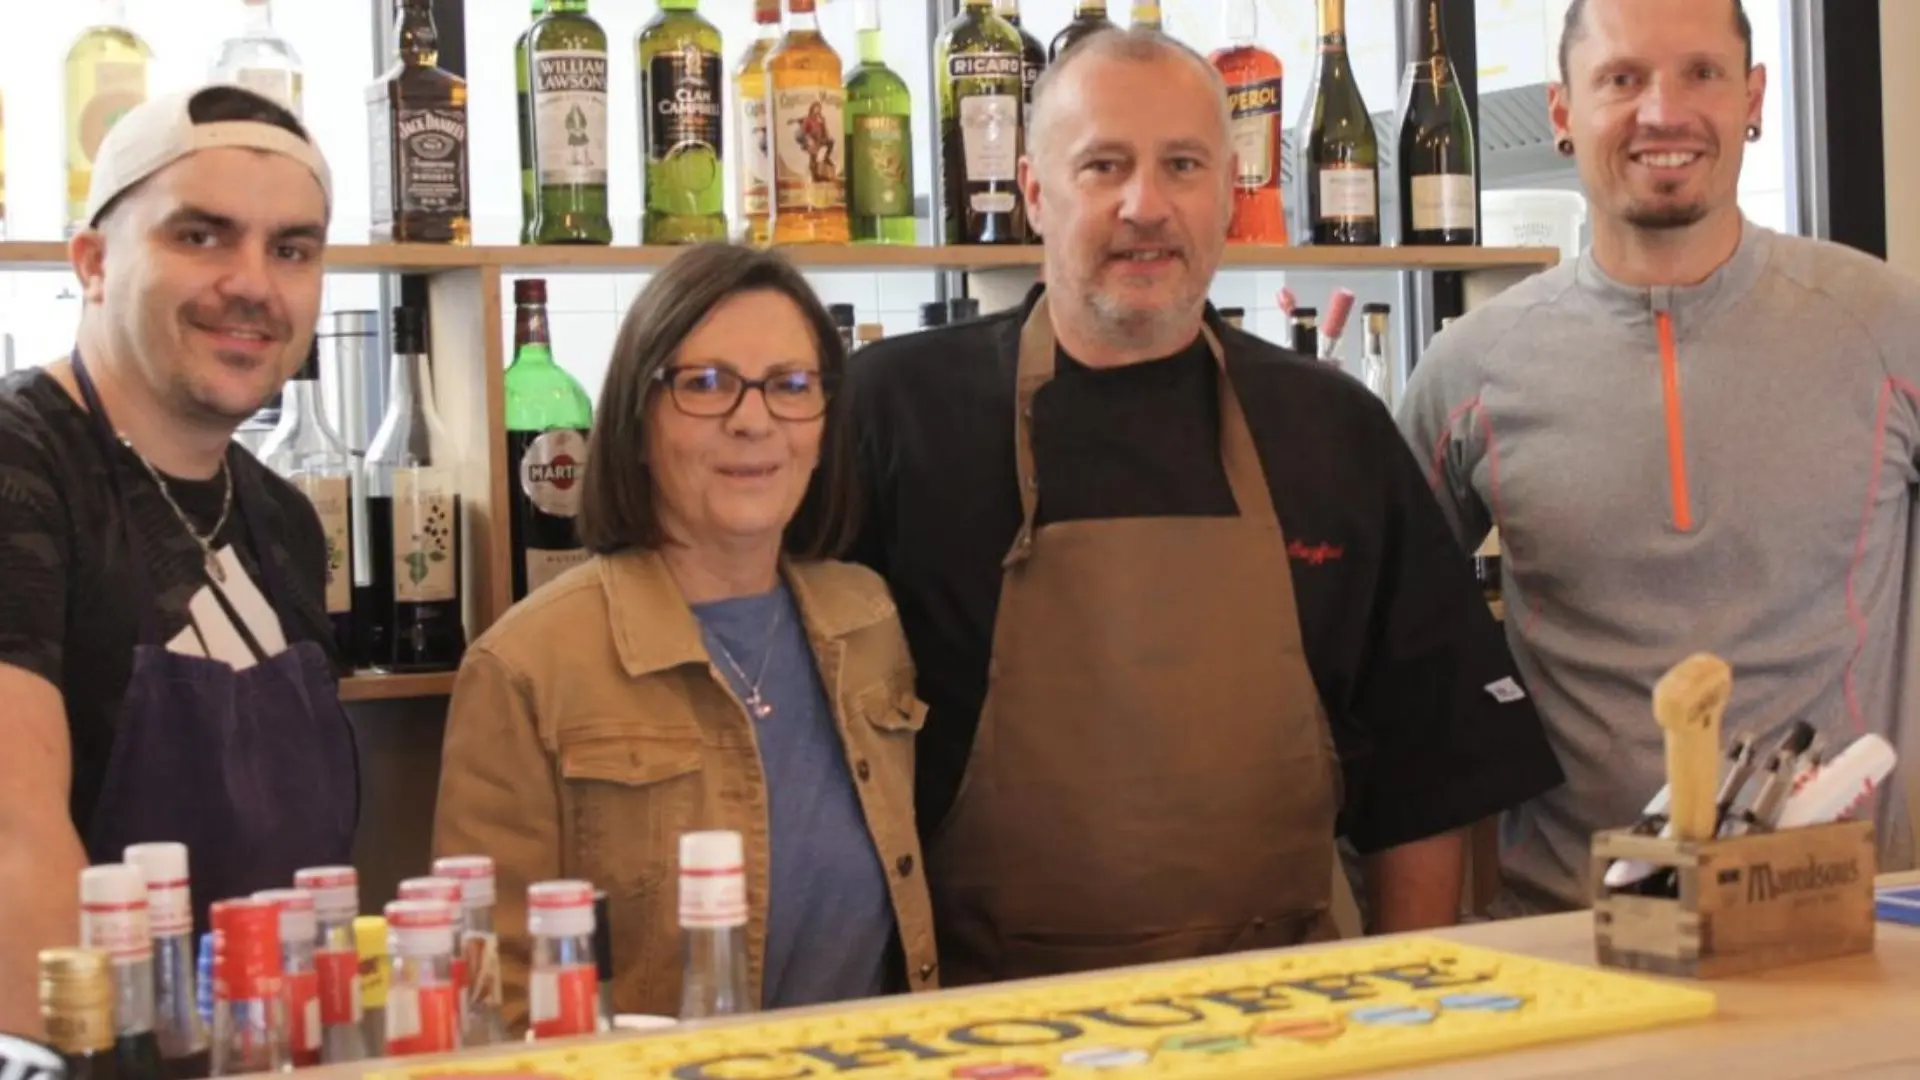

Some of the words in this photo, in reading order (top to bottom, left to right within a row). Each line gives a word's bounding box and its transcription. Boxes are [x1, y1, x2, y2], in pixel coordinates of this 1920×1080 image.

[540, 59, 606, 74] WILLIAM
[954, 57, 1019, 73] RICARD
[675, 88, 711, 102] CLAN
[1226, 87, 1277, 110] PEROL
[671, 955, 1499, 1079] CHOUFFE
